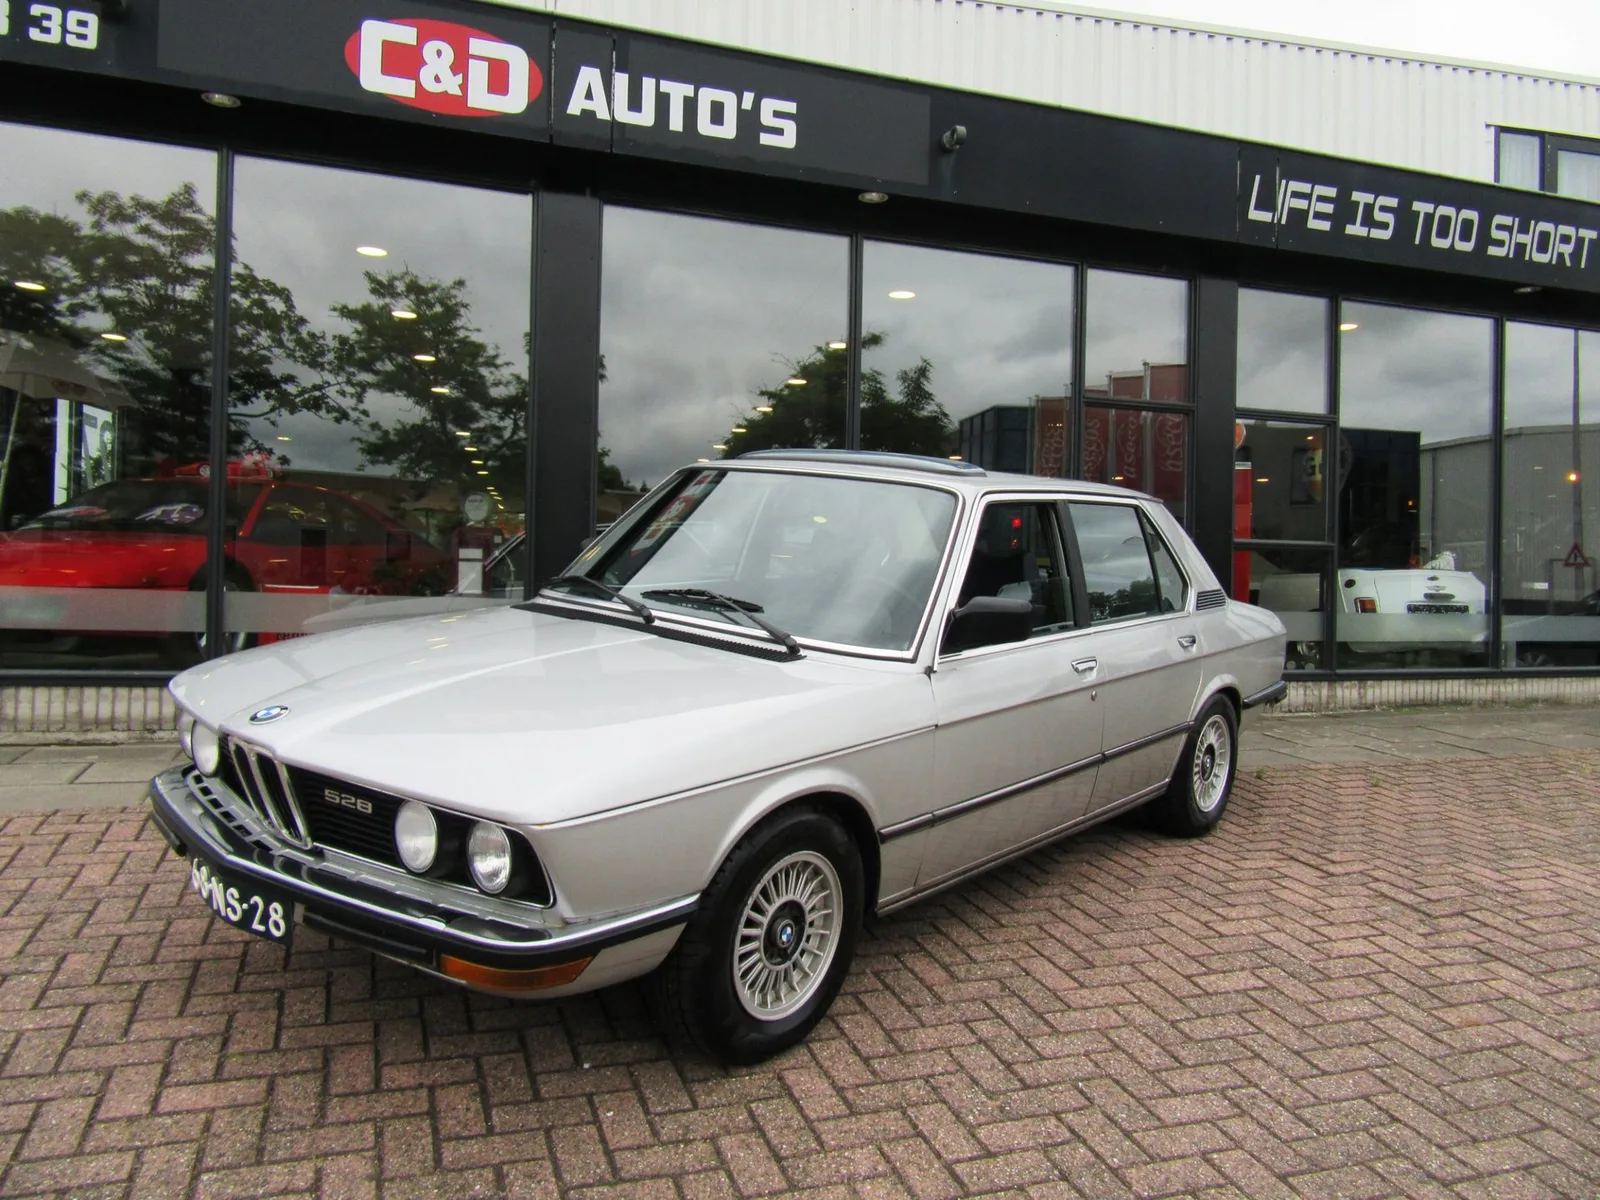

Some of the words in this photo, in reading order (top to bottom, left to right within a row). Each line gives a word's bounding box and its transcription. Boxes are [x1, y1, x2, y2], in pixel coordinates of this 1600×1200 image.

[29, 4, 98, 50] 39
[359, 19, 529, 114] C&D
[566, 65, 797, 149] AUTO'S
[1248, 175, 1337, 231] LIFE
[1345, 191, 1398, 240] IS
[1412, 201, 1478, 252] TOO
[1487, 214, 1598, 268] SHORT
[324, 788, 372, 814] 528
